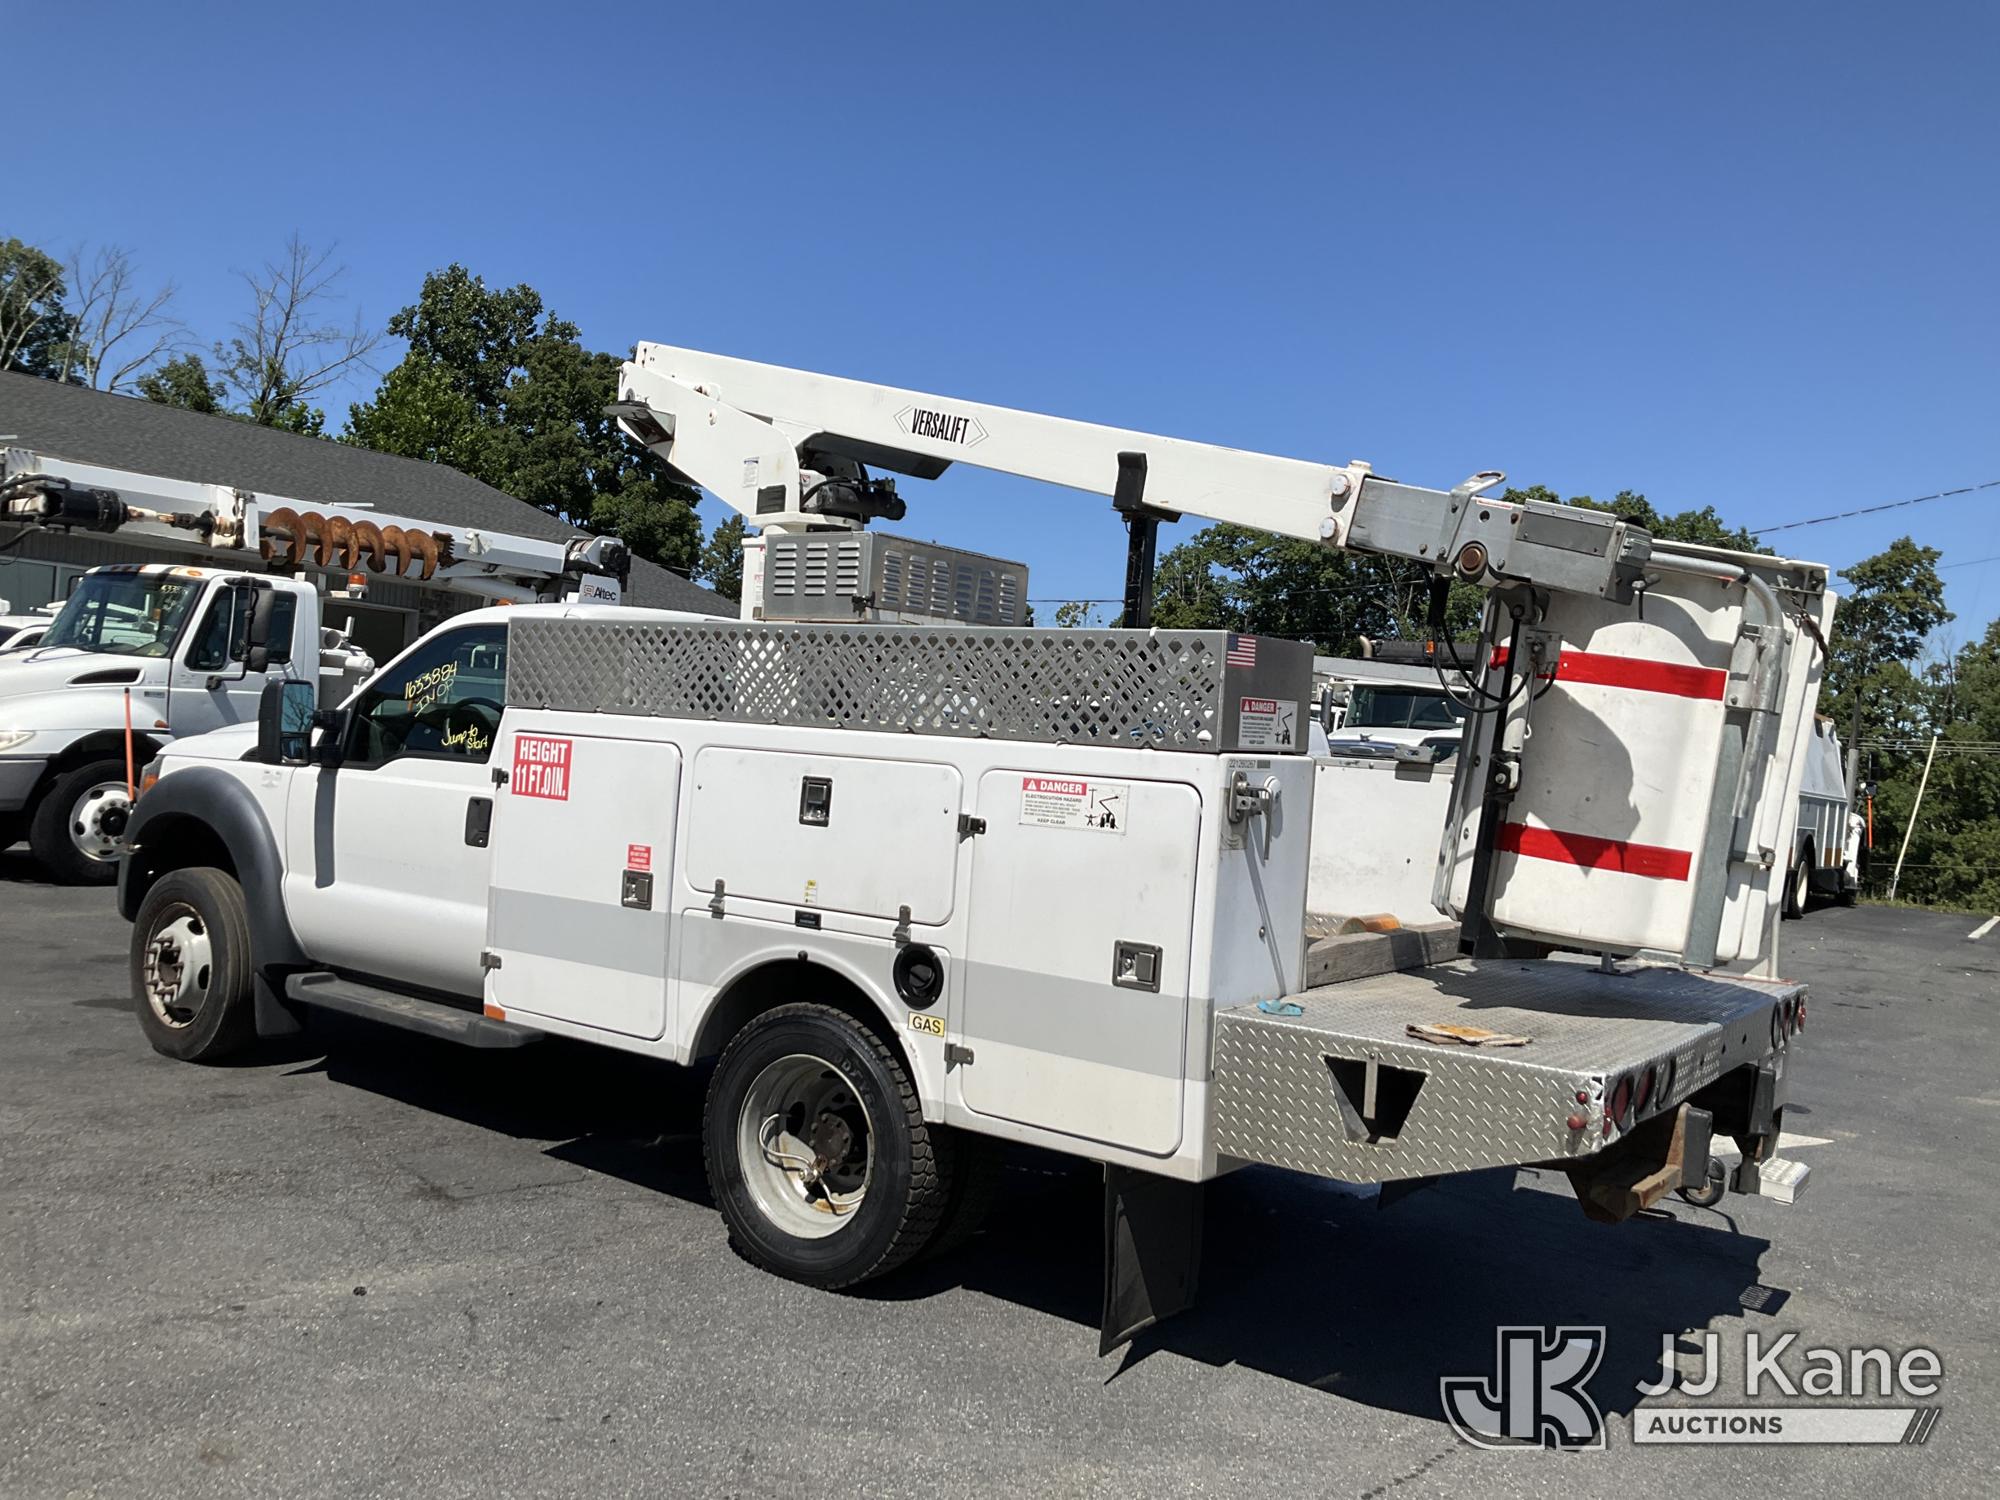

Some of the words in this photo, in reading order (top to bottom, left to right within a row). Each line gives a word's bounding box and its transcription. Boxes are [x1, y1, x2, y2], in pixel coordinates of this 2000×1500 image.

[911, 408, 970, 444] VERSALIFT
[593, 586, 617, 601] Altec
[404, 660, 458, 700] 1633884
[1250, 700, 1276, 713] DANGER
[467, 723, 478, 738] to
[520, 739, 568, 764] HEIGHT
[1039, 780, 1083, 794] DANGER
[912, 1016, 942, 1034] GAS
